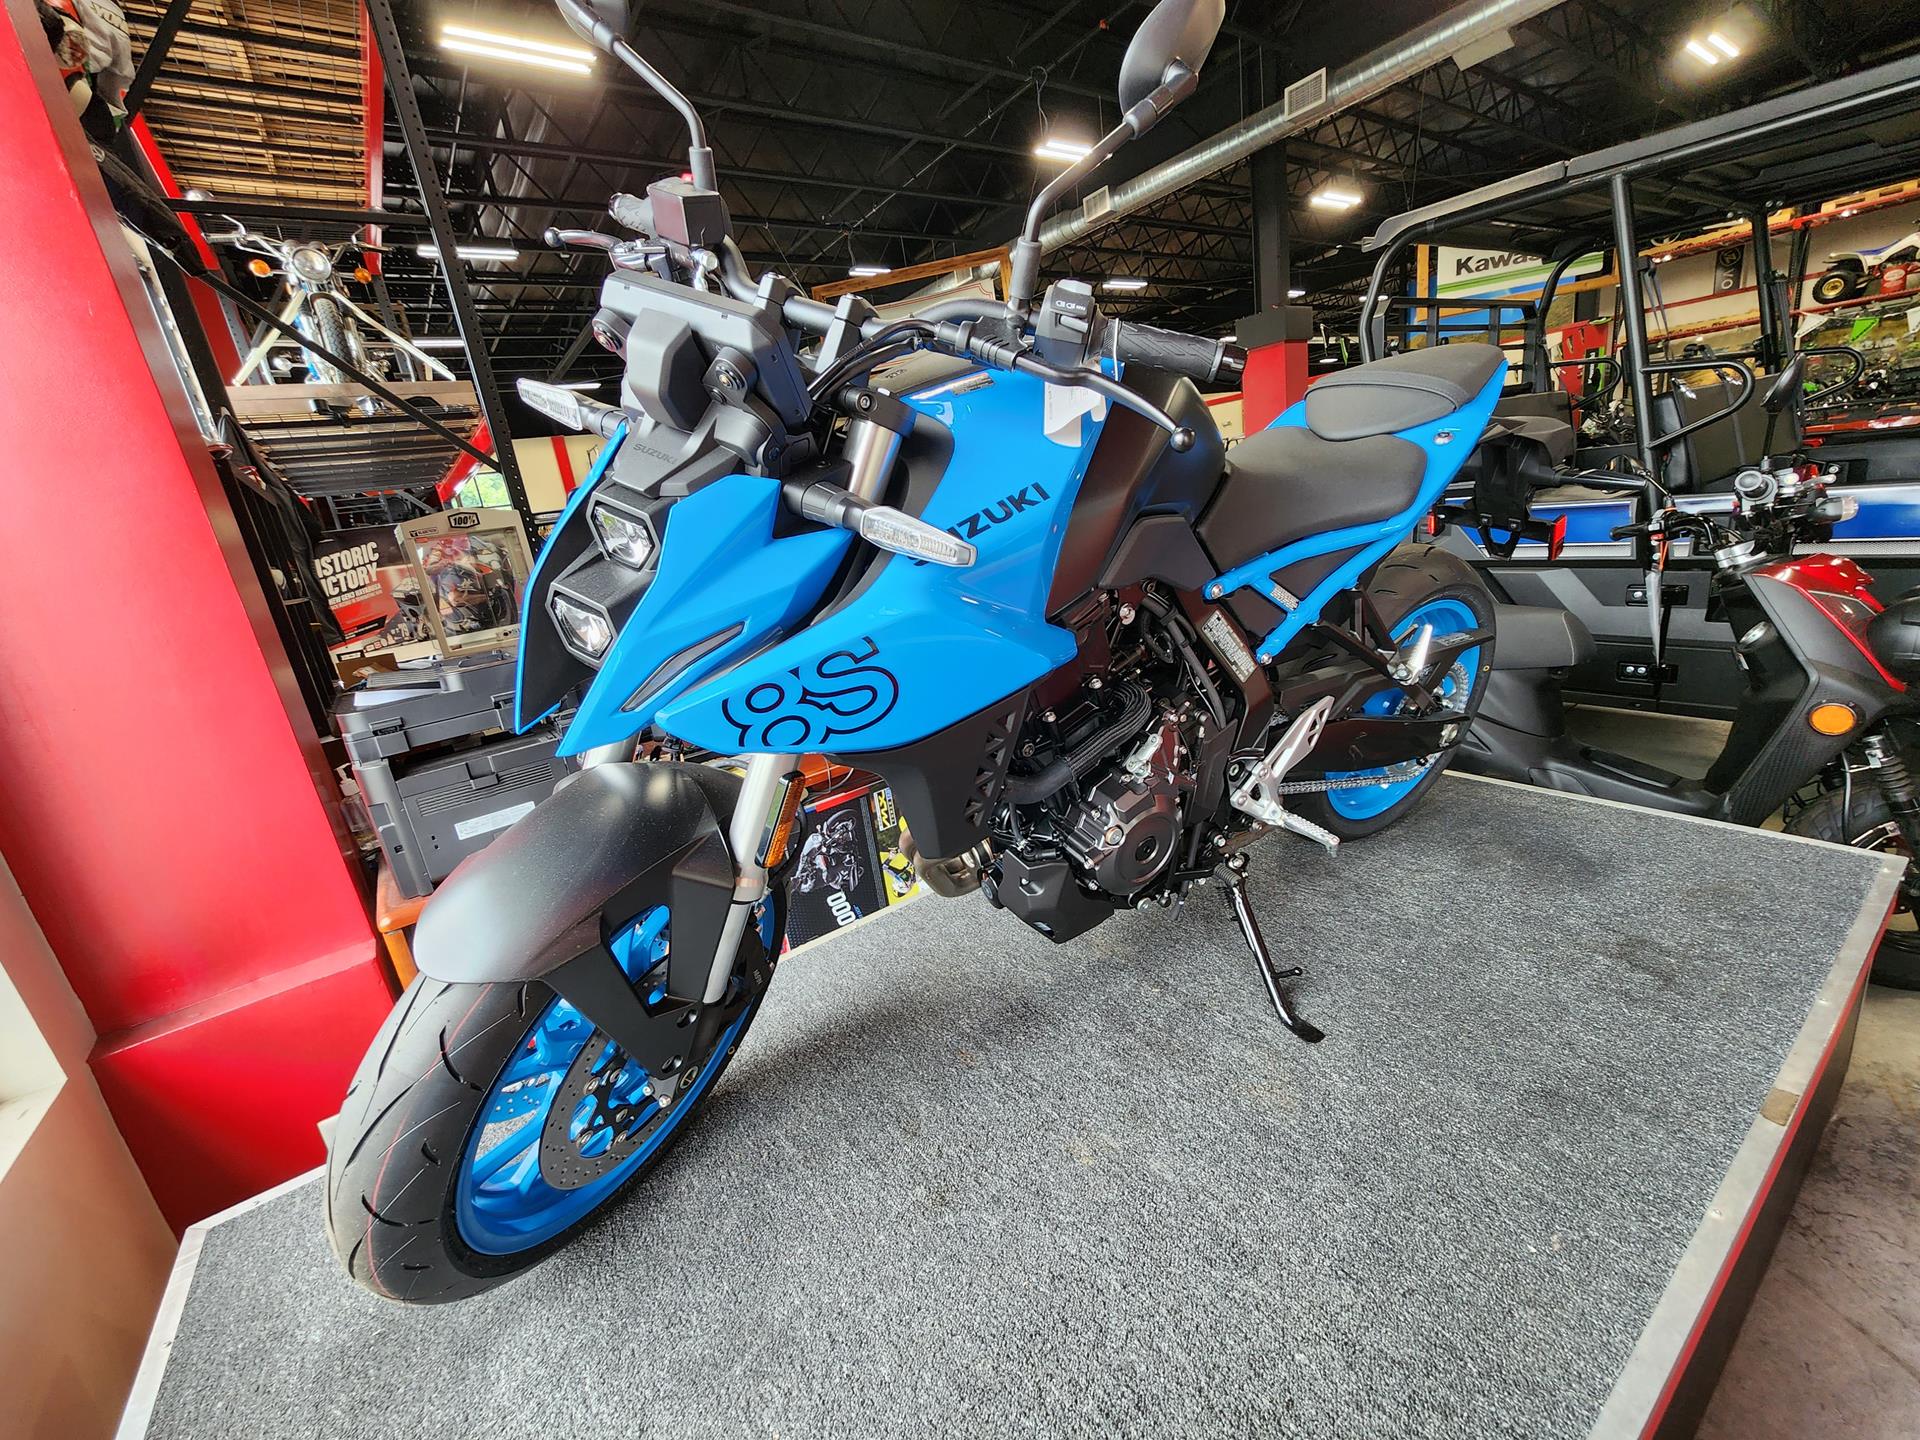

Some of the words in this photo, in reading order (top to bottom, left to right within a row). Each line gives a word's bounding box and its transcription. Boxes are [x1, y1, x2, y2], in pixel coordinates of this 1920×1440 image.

[633, 443, 678, 465] SUZUKI
[453, 516, 476, 526] 100%
[906, 482, 1051, 567] ZUKI
[314, 541, 380, 578] ISTORIC
[320, 562, 378, 597] ICTORY
[826, 891, 857, 927] 000
